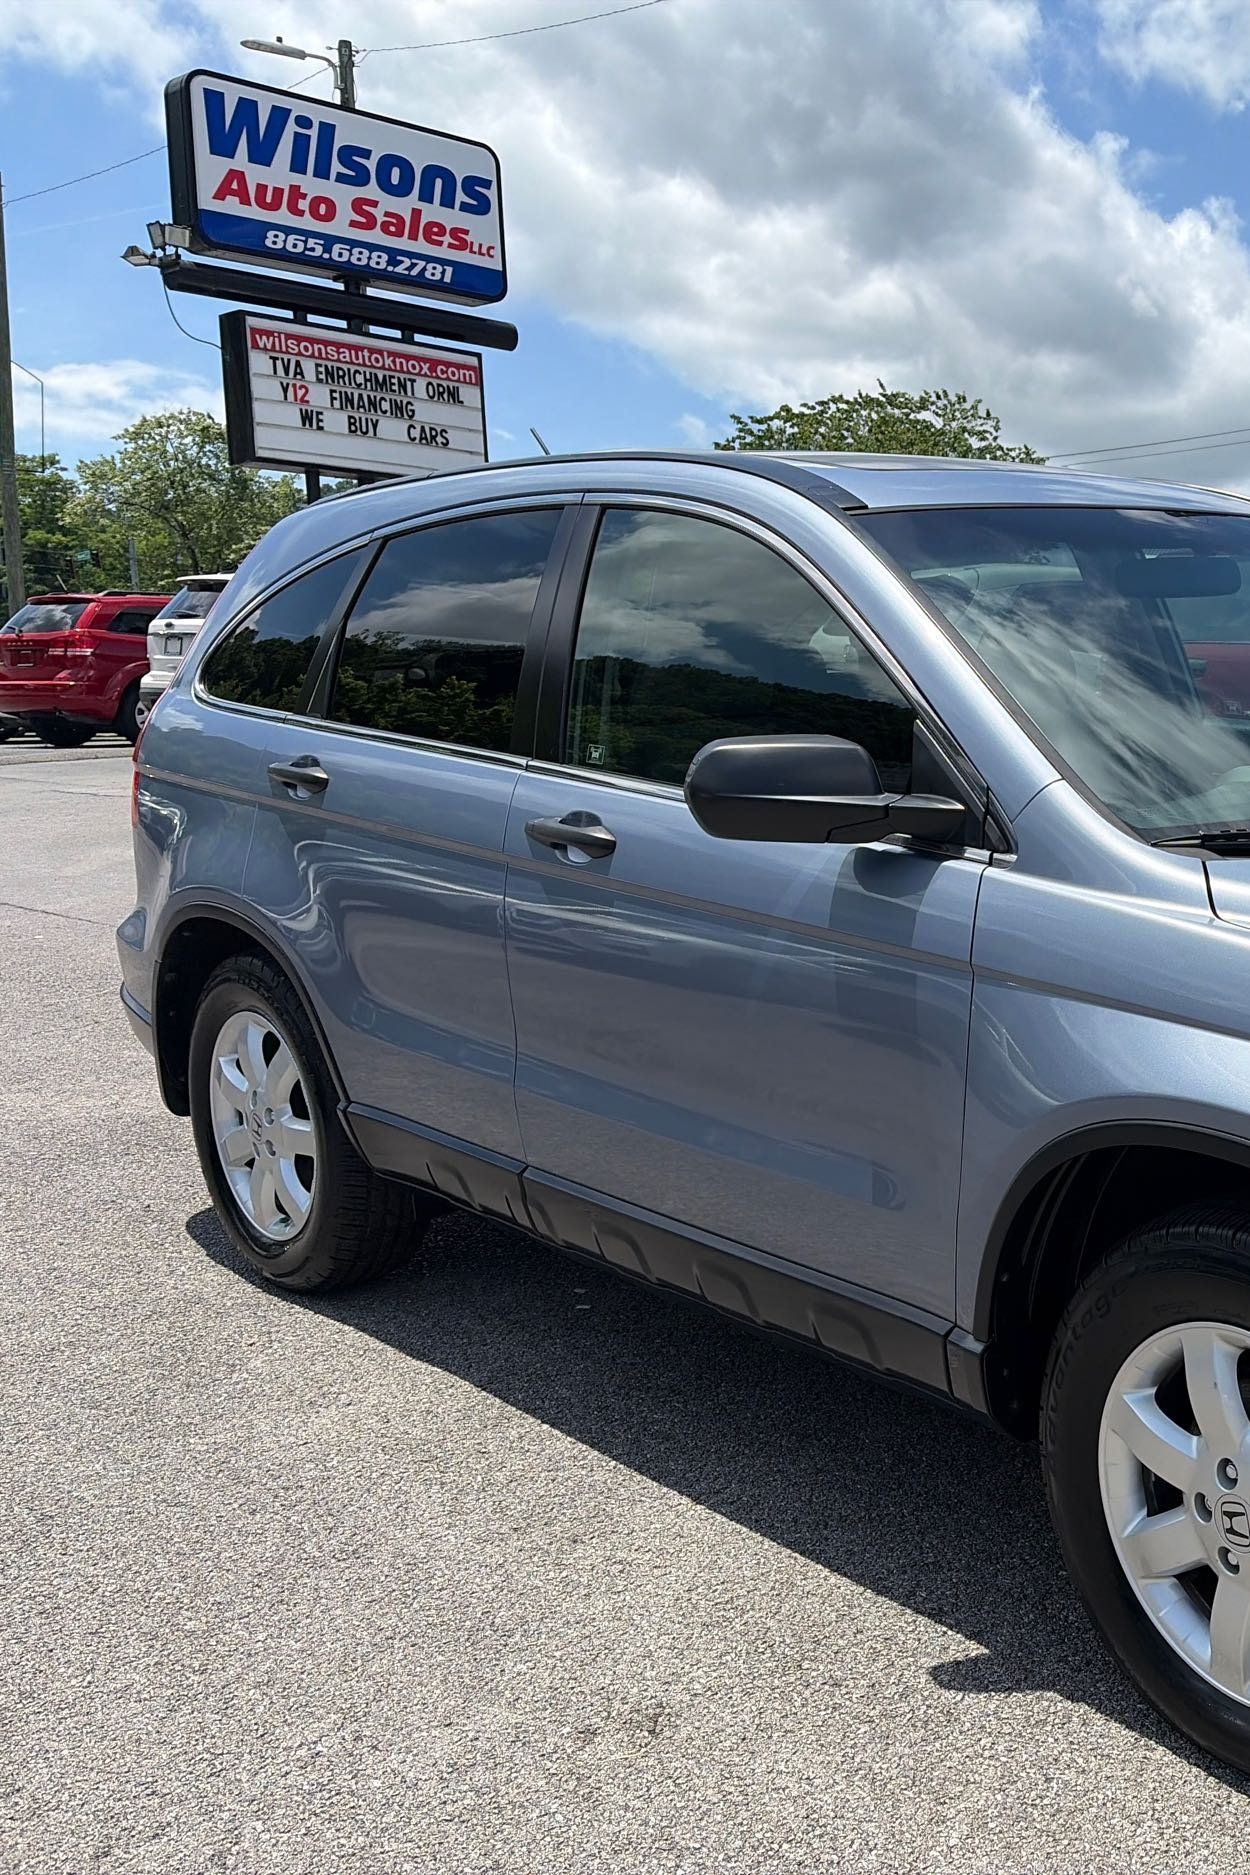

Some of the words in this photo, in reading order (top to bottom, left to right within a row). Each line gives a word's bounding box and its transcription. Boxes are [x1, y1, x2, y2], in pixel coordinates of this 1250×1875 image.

[203, 87, 493, 216] Wilsons
[212, 168, 337, 223] Auto
[348, 197, 470, 251] Sales
[469, 241, 496, 259] LLC
[264, 230, 454, 283] 865.688.2781
[255, 332, 476, 384] wilsonsautoknox.com
[269, 355, 305, 379] TVA
[315, 363, 417, 397] ENRICHMENT
[426, 381, 464, 405] ORNL
[280, 381, 310, 404] Y12
[329, 389, 416, 420] FINANCING
[299, 408, 324, 431] WE
[347, 414, 379, 437] BUY
[407, 424, 450, 447] CARS
